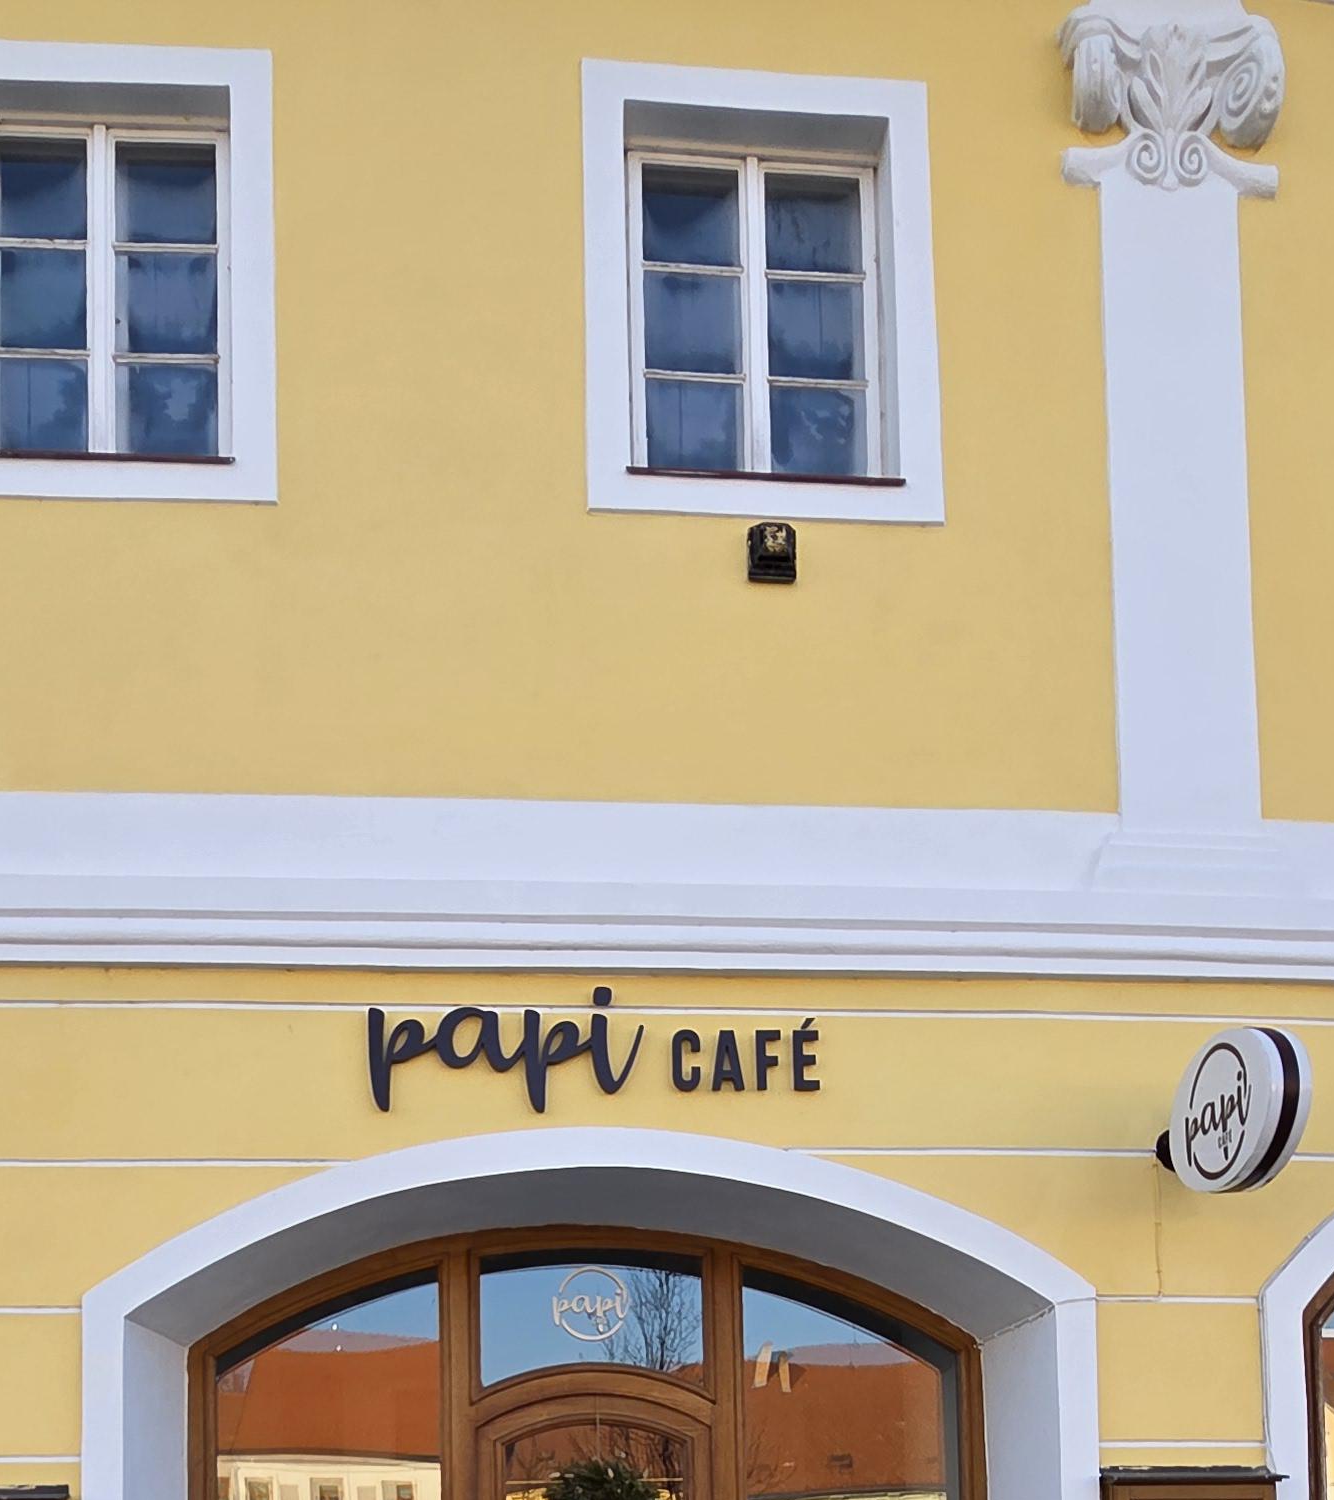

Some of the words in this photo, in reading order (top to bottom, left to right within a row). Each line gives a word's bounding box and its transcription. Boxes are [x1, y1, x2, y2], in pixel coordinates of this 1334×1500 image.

[367, 986, 644, 1113] papi
[671, 1017, 821, 1092] CAFÉ
[1184, 1070, 1252, 1168] papi
[552, 1288, 630, 1333] papi
